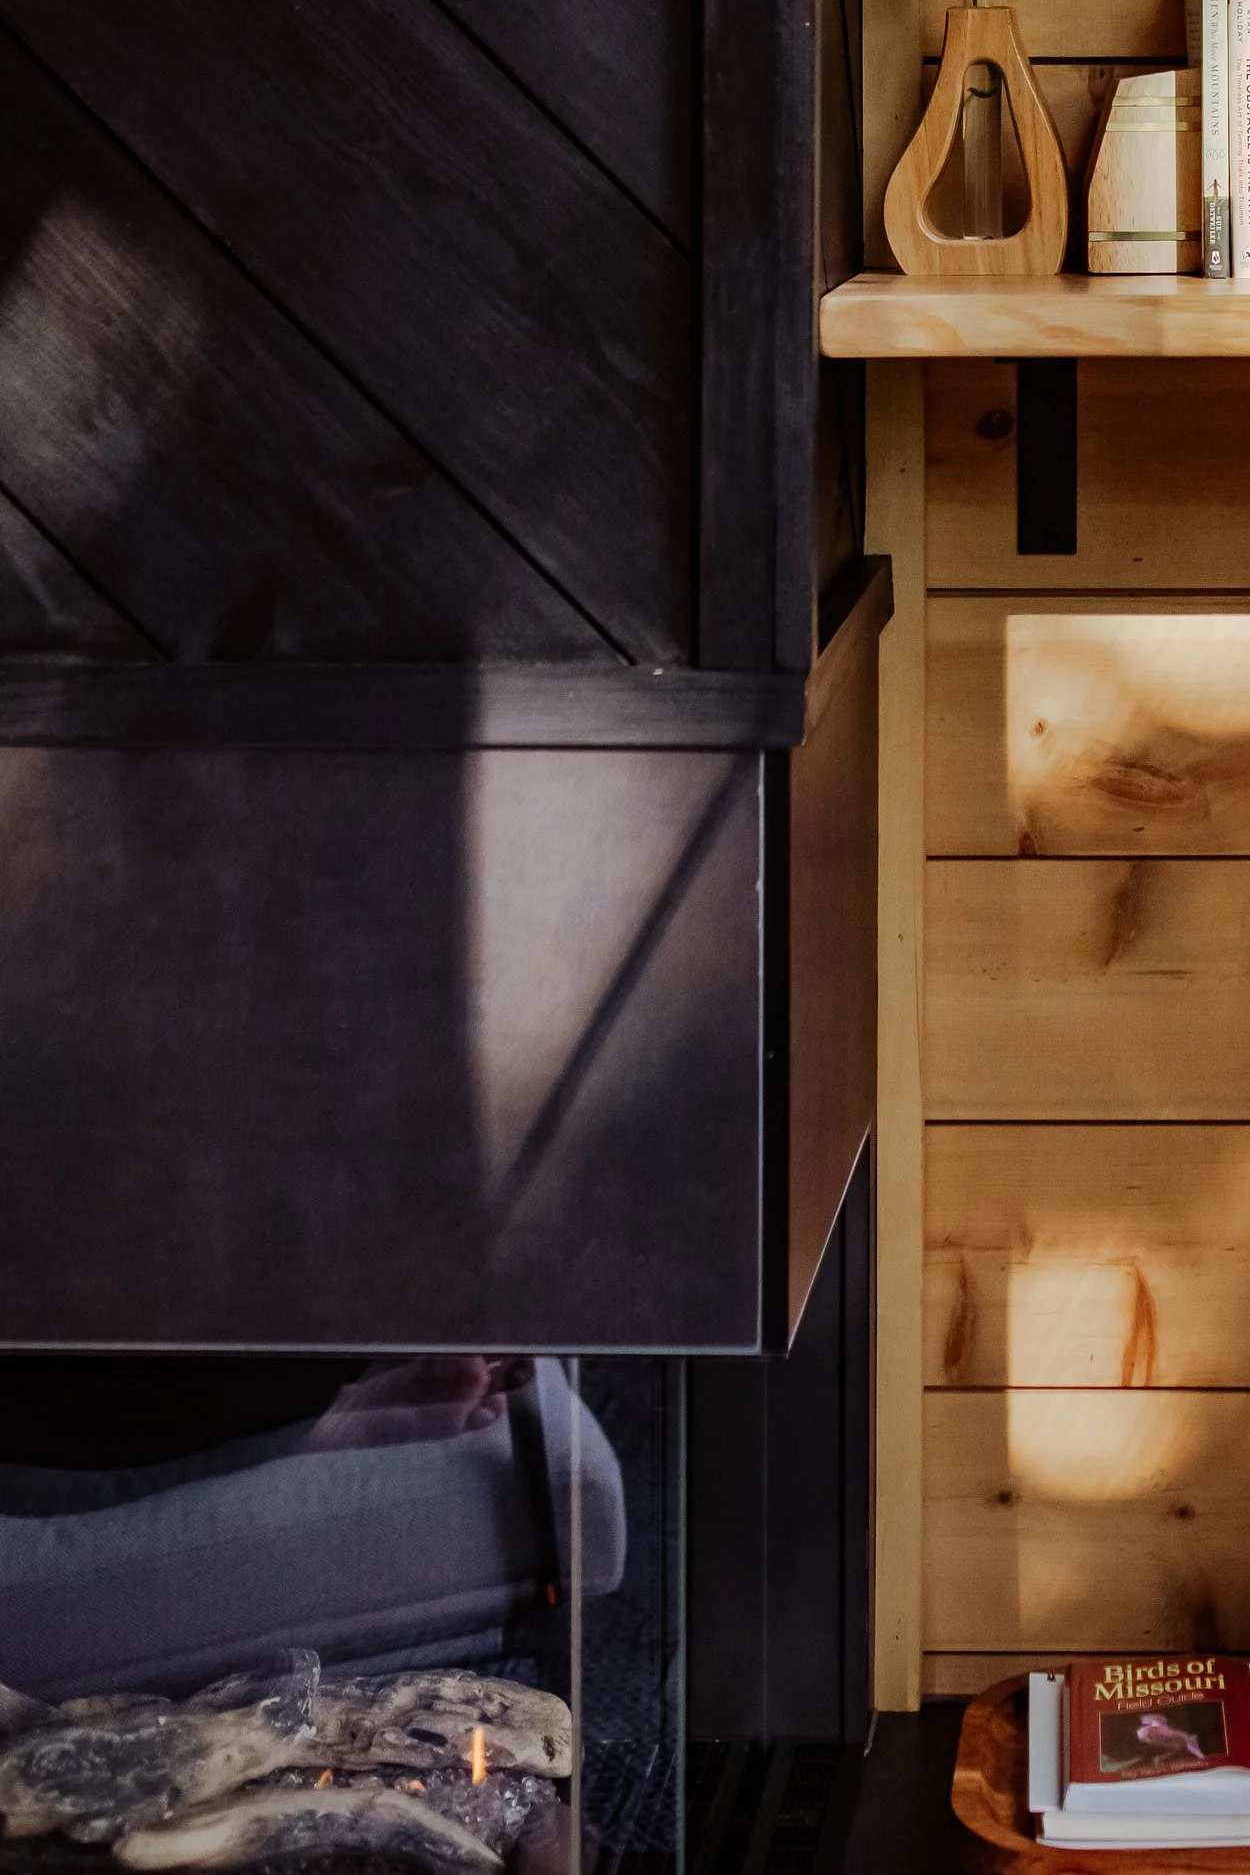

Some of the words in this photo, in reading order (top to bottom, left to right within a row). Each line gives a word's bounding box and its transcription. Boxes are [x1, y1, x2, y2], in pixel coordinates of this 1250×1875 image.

[1236, 1, 1244, 43] HOLIDAY
[1210, 64, 1220, 136] MOUNTAINS
[1236, 106, 1244, 119] Art
[1236, 120, 1244, 128] of
[1236, 129, 1244, 154] Turning
[1237, 156, 1245, 176] Trials
[1237, 178, 1245, 194] into
[1237, 196, 1245, 225] Triumph
[1104, 1660, 1180, 1684] Birds
[1186, 1658, 1216, 1675] of
[1094, 1673, 1226, 1701] Missouri
[1117, 1697, 1153, 1711] Field
[1157, 1692, 1205, 1706] Guide
